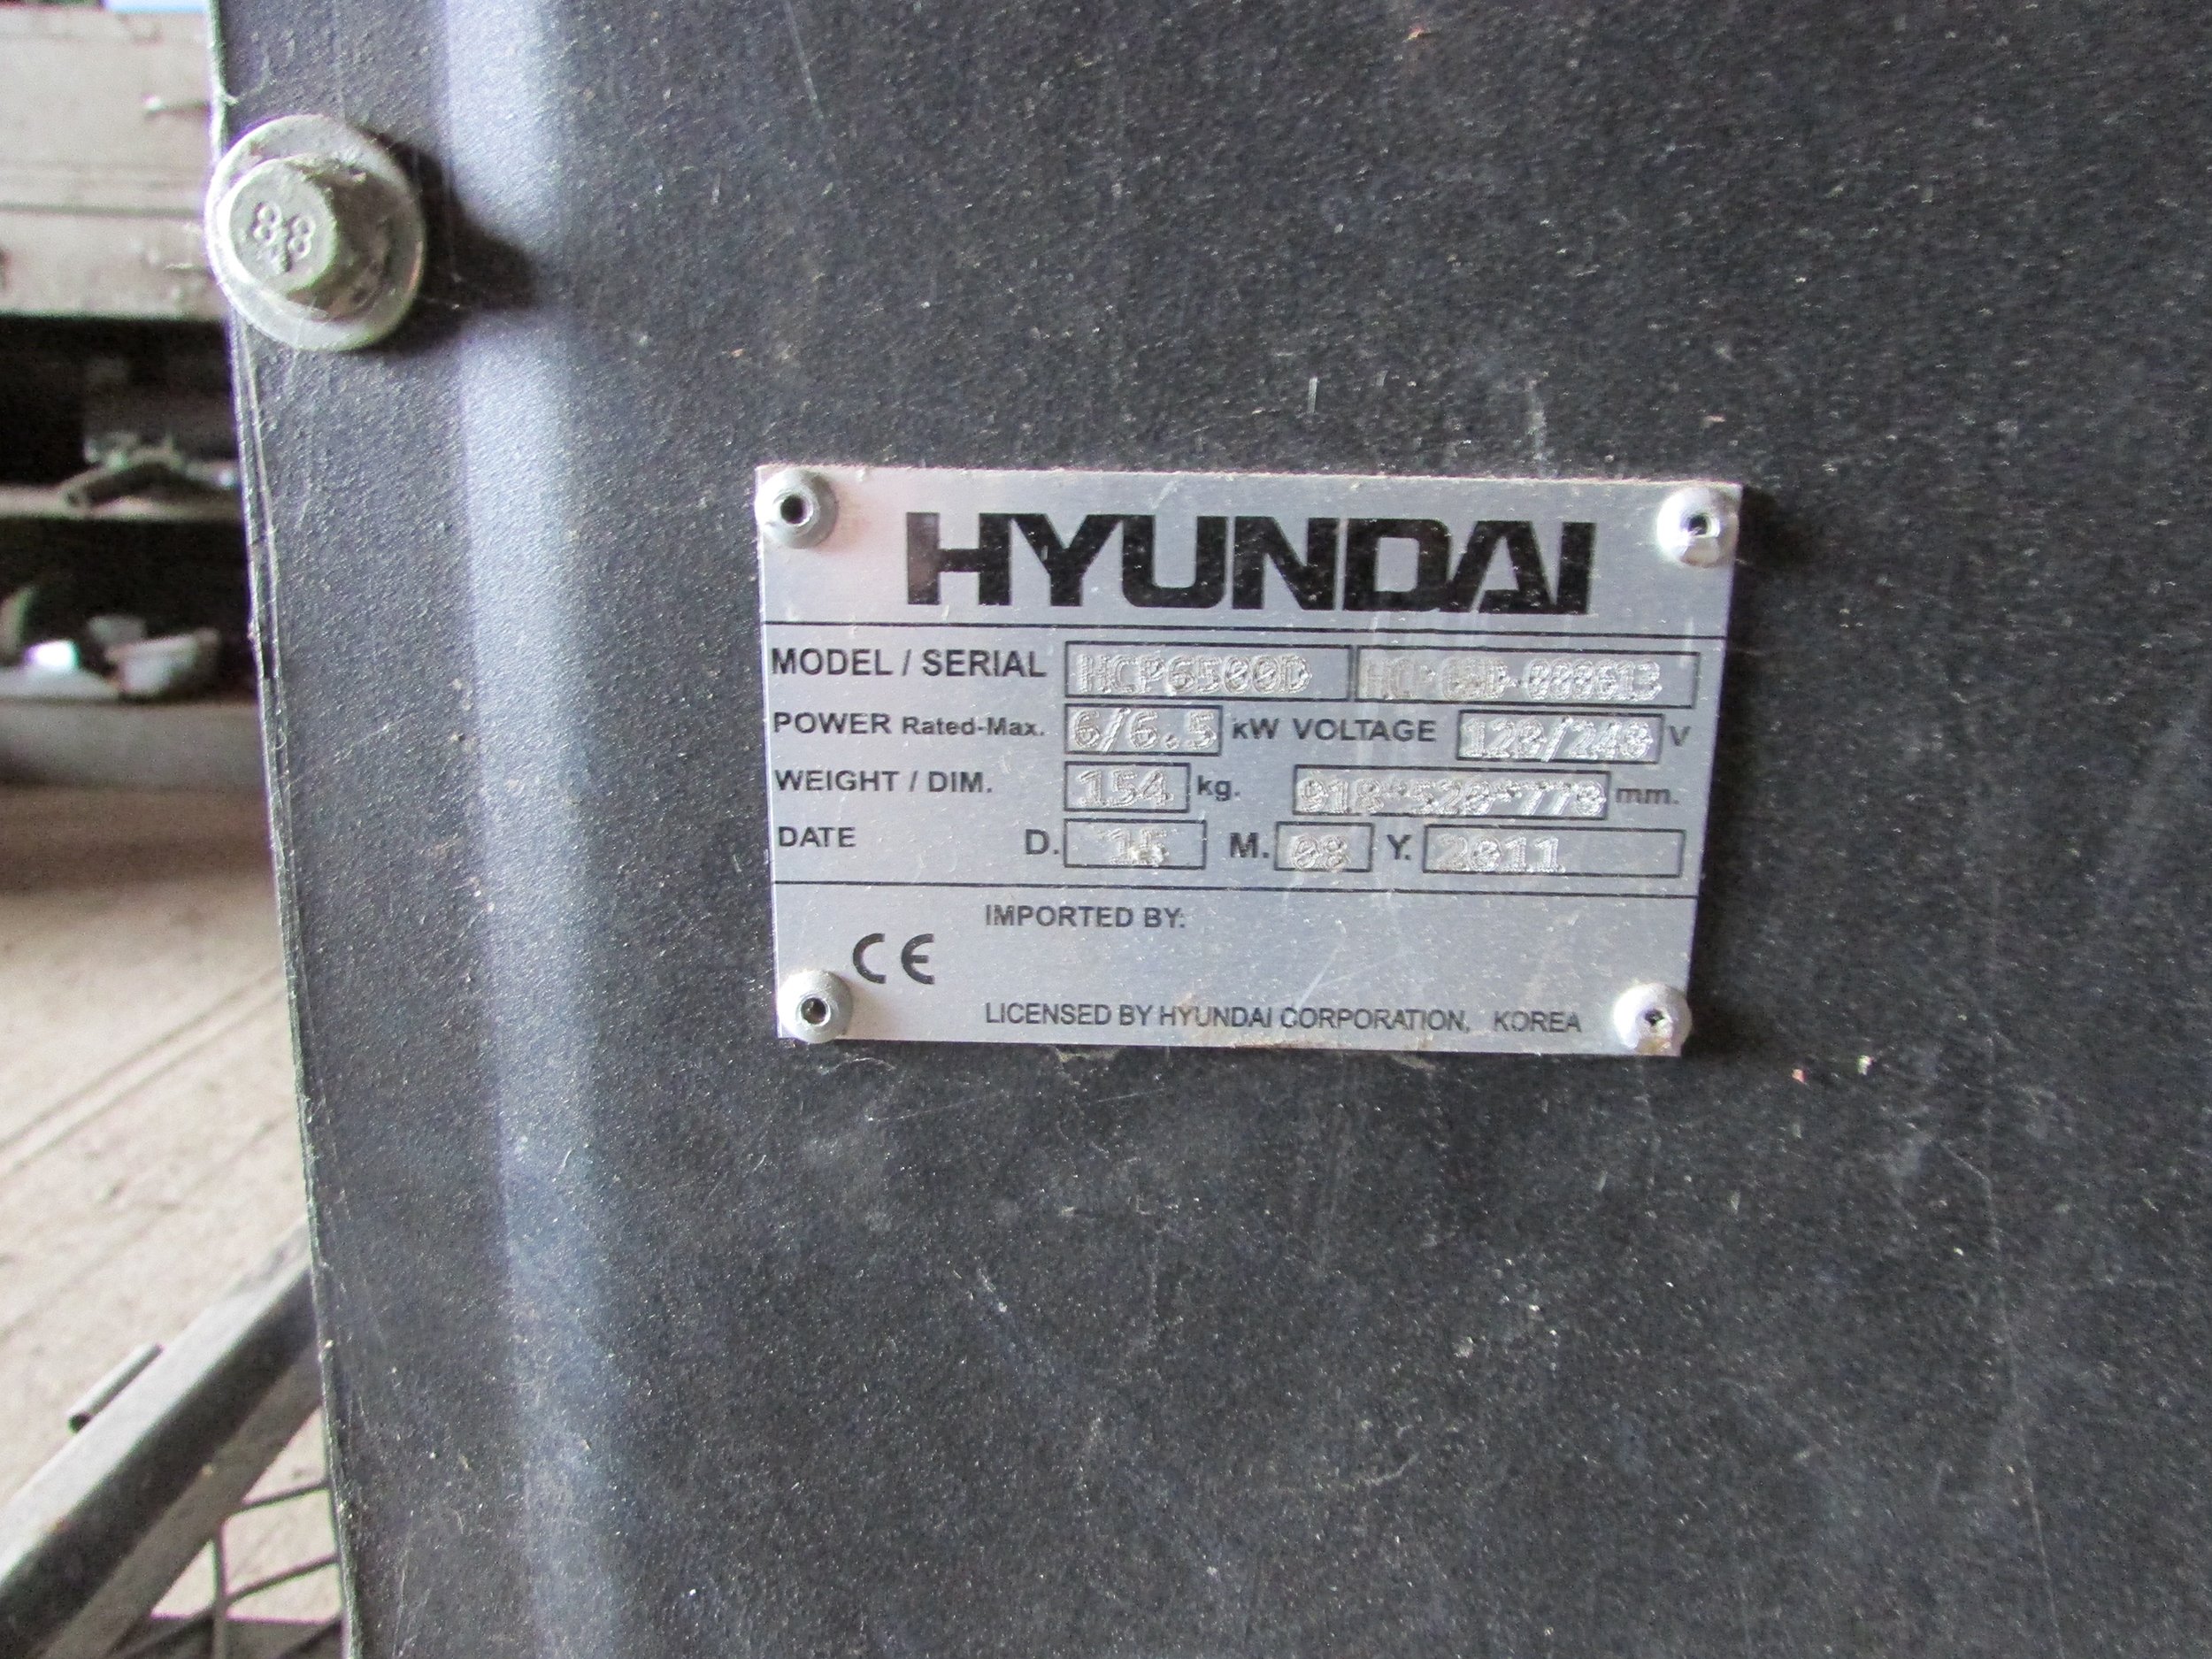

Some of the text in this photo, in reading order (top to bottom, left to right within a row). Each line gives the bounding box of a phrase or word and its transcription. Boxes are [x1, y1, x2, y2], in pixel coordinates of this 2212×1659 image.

[906, 511, 1597, 616] HYUNDAI
[772, 648, 1047, 677] MODEL / SERIAL
[773, 711, 1045, 736] POWER Rated-Max.
[1070, 708, 1217, 752] 6/6.5
[1232, 718, 1437, 743] kW VOLTAGE
[1668, 726, 1691, 747] V
[775, 770, 993, 793] WEIGHT / DIM.
[1075, 769, 1174, 807] 154
[1197, 775, 1240, 802] kg.
[1617, 787, 1680, 805] mm.
[778, 826, 856, 848] DATE
[1025, 829, 1060, 856] D.
[1230, 833, 1270, 859] M.
[1386, 834, 1412, 861] Y.
[1433, 833, 1566, 873] 2011
[985, 905, 1187, 928] IMPORTED BY:
[853, 933, 935, 985] CE
[986, 1002, 1112, 1025] LICENSED
[1119, 1005, 1153, 1026] BY
[1159, 1006, 1272, 1028] HYUNDAI
[1494, 1010, 1582, 1033] KOREA
